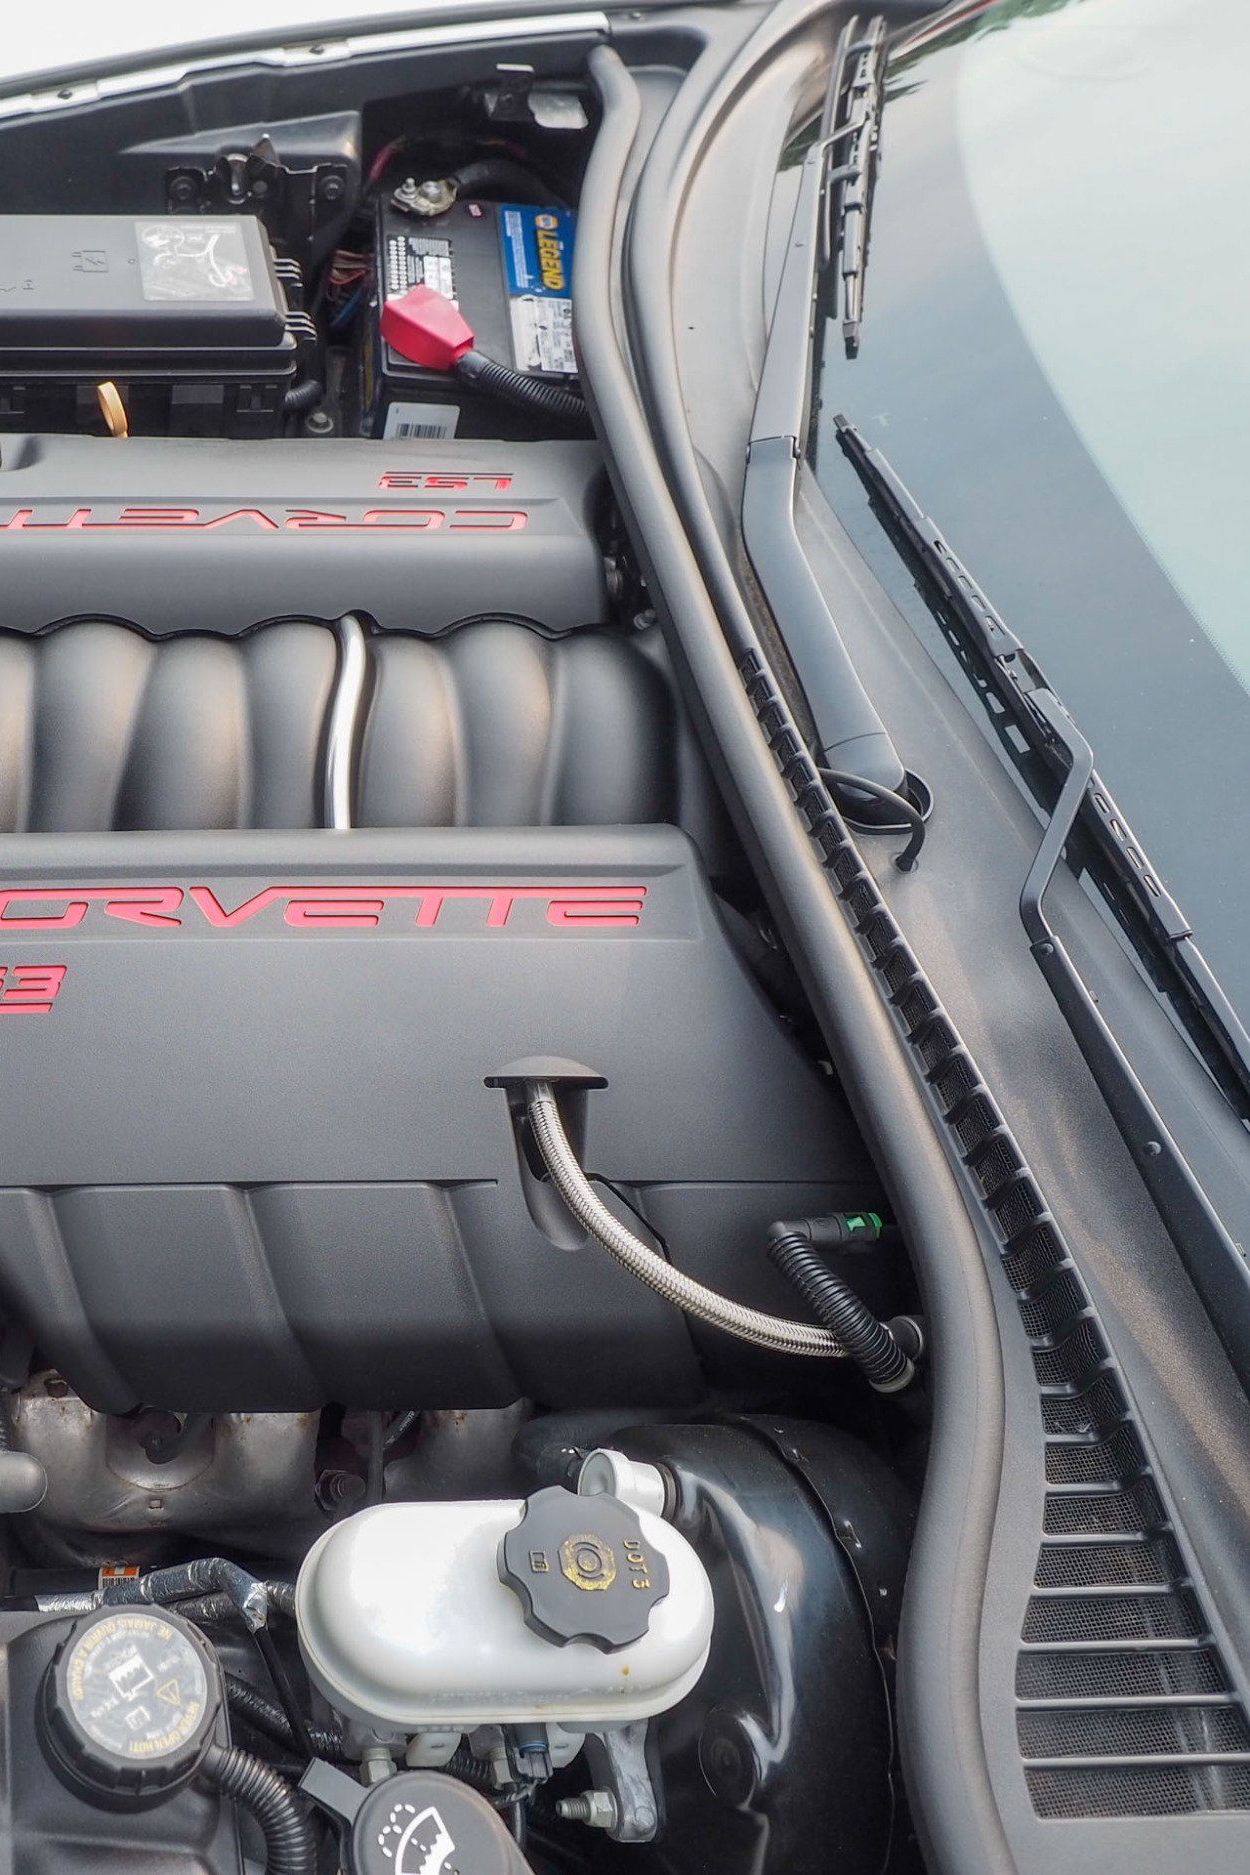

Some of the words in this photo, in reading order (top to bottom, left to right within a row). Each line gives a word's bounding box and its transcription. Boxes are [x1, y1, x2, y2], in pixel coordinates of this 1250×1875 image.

[536, 229, 565, 291] LEGEND
[378, 474, 512, 490] LS3
[623, 1538, 648, 1575] DOT
